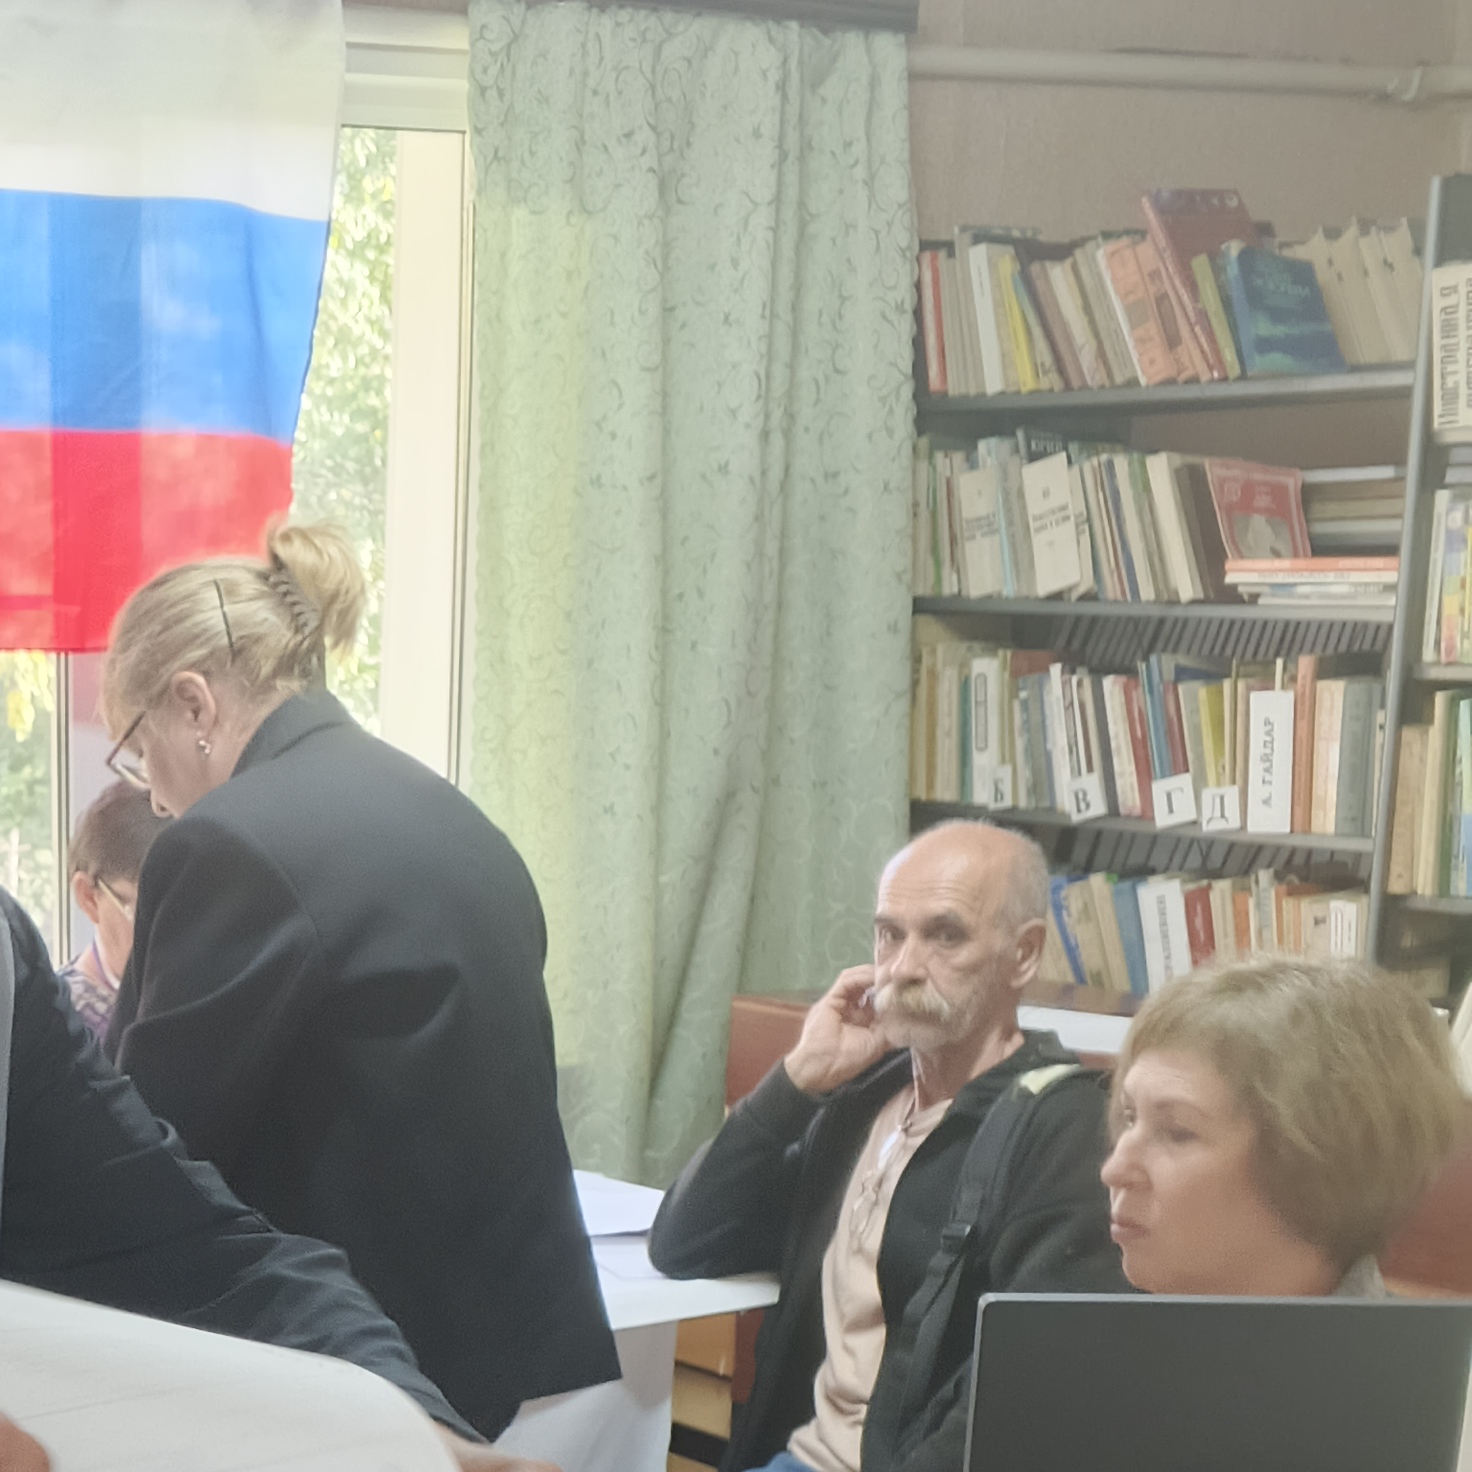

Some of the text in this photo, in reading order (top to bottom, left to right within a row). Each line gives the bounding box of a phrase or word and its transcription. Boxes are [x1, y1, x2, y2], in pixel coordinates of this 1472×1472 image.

[1259, 716, 1275, 787] ГАЙДАР
[1073, 787, 1091, 814] В
[1163, 786, 1185, 815] Г
[1206, 793, 1230, 828] Д
